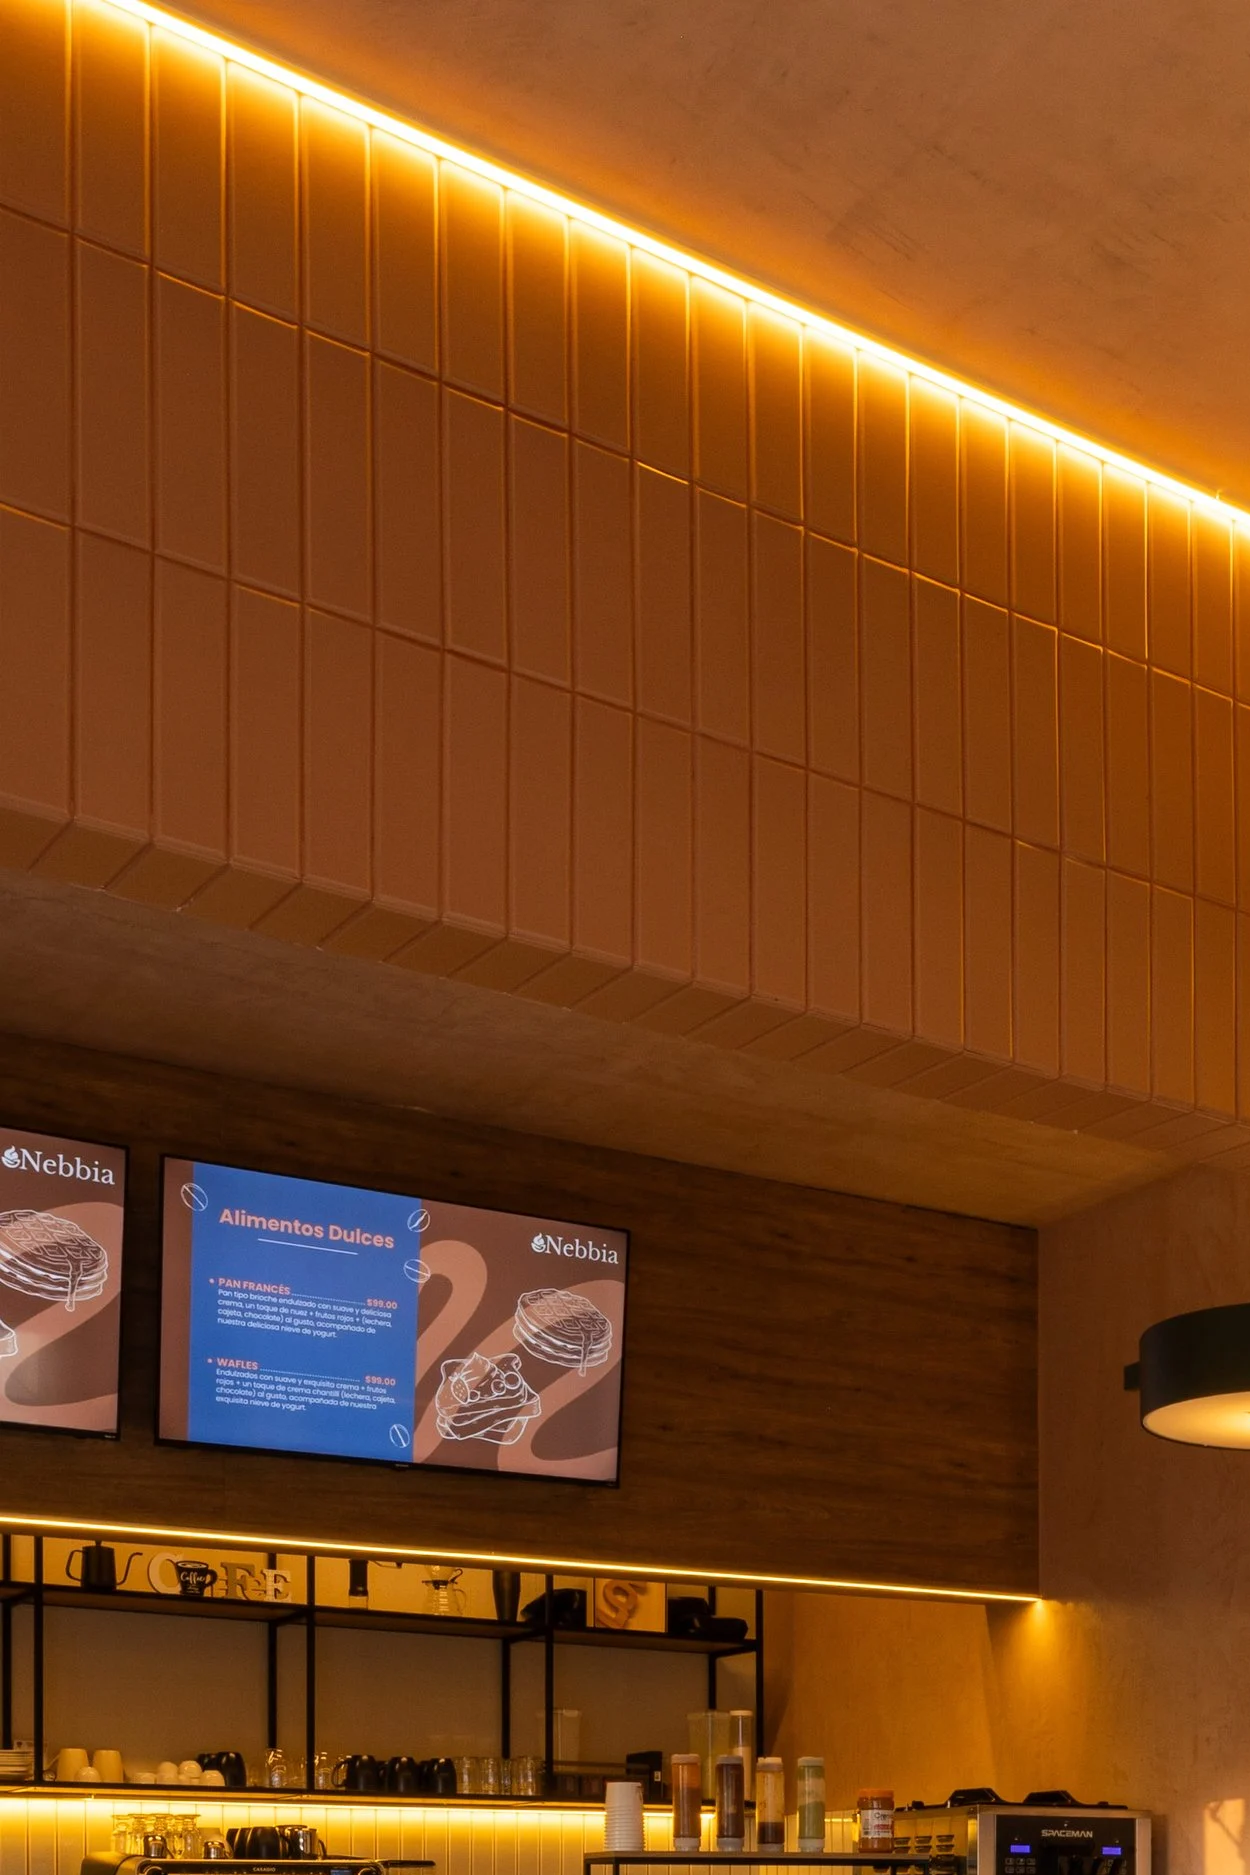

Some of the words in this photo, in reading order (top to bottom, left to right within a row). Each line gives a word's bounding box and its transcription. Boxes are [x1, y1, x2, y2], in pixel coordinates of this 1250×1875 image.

[20, 1148, 115, 1185] Nebbia
[219, 1208, 324, 1239] Alimentos
[328, 1224, 395, 1249] Dulces
[545, 1234, 619, 1264] Nebbia
[218, 1277, 241, 1289] PAN
[242, 1281, 291, 1296] FRANCÉS
[367, 1298, 398, 1310] $99.00
[218, 1289, 233, 1297] Pan
[234, 1291, 249, 1300] tipo
[249, 1293, 278, 1303] brioche
[333, 1305, 354, 1313] suave
[360, 1308, 392, 1318] deliciosa
[256, 1303, 278, 1313] toque
[279, 1306, 289, 1314] de
[315, 1310, 336, 1320] frutos
[337, 1315, 354, 1323] rojos
[217, 1317, 246, 1327] nuestra
[246, 1320, 280, 1331] deliciosa
[281, 1325, 300, 1333] nieve
[301, 1327, 311, 1335] de
[217, 1357, 258, 1370] WAFLES
[365, 1375, 396, 1386] $99.00
[216, 1378, 234, 1386] rojos
[253, 1381, 275, 1390] toque
[287, 1386, 311, 1394] crema
[274, 1375, 296, 1383] suave
[336, 1383, 359, 1391] crema
[366, 1385, 387, 1394] frutos
[249, 1399, 269, 1407] nieve
[339, 1399, 349, 1407] de
[349, 1401, 377, 1410] nuestra
[148, 1552, 292, 1603] CFE
[180, 1570, 206, 1584] Coffee
[1041, 1829, 1093, 1838] SPACEMAN
